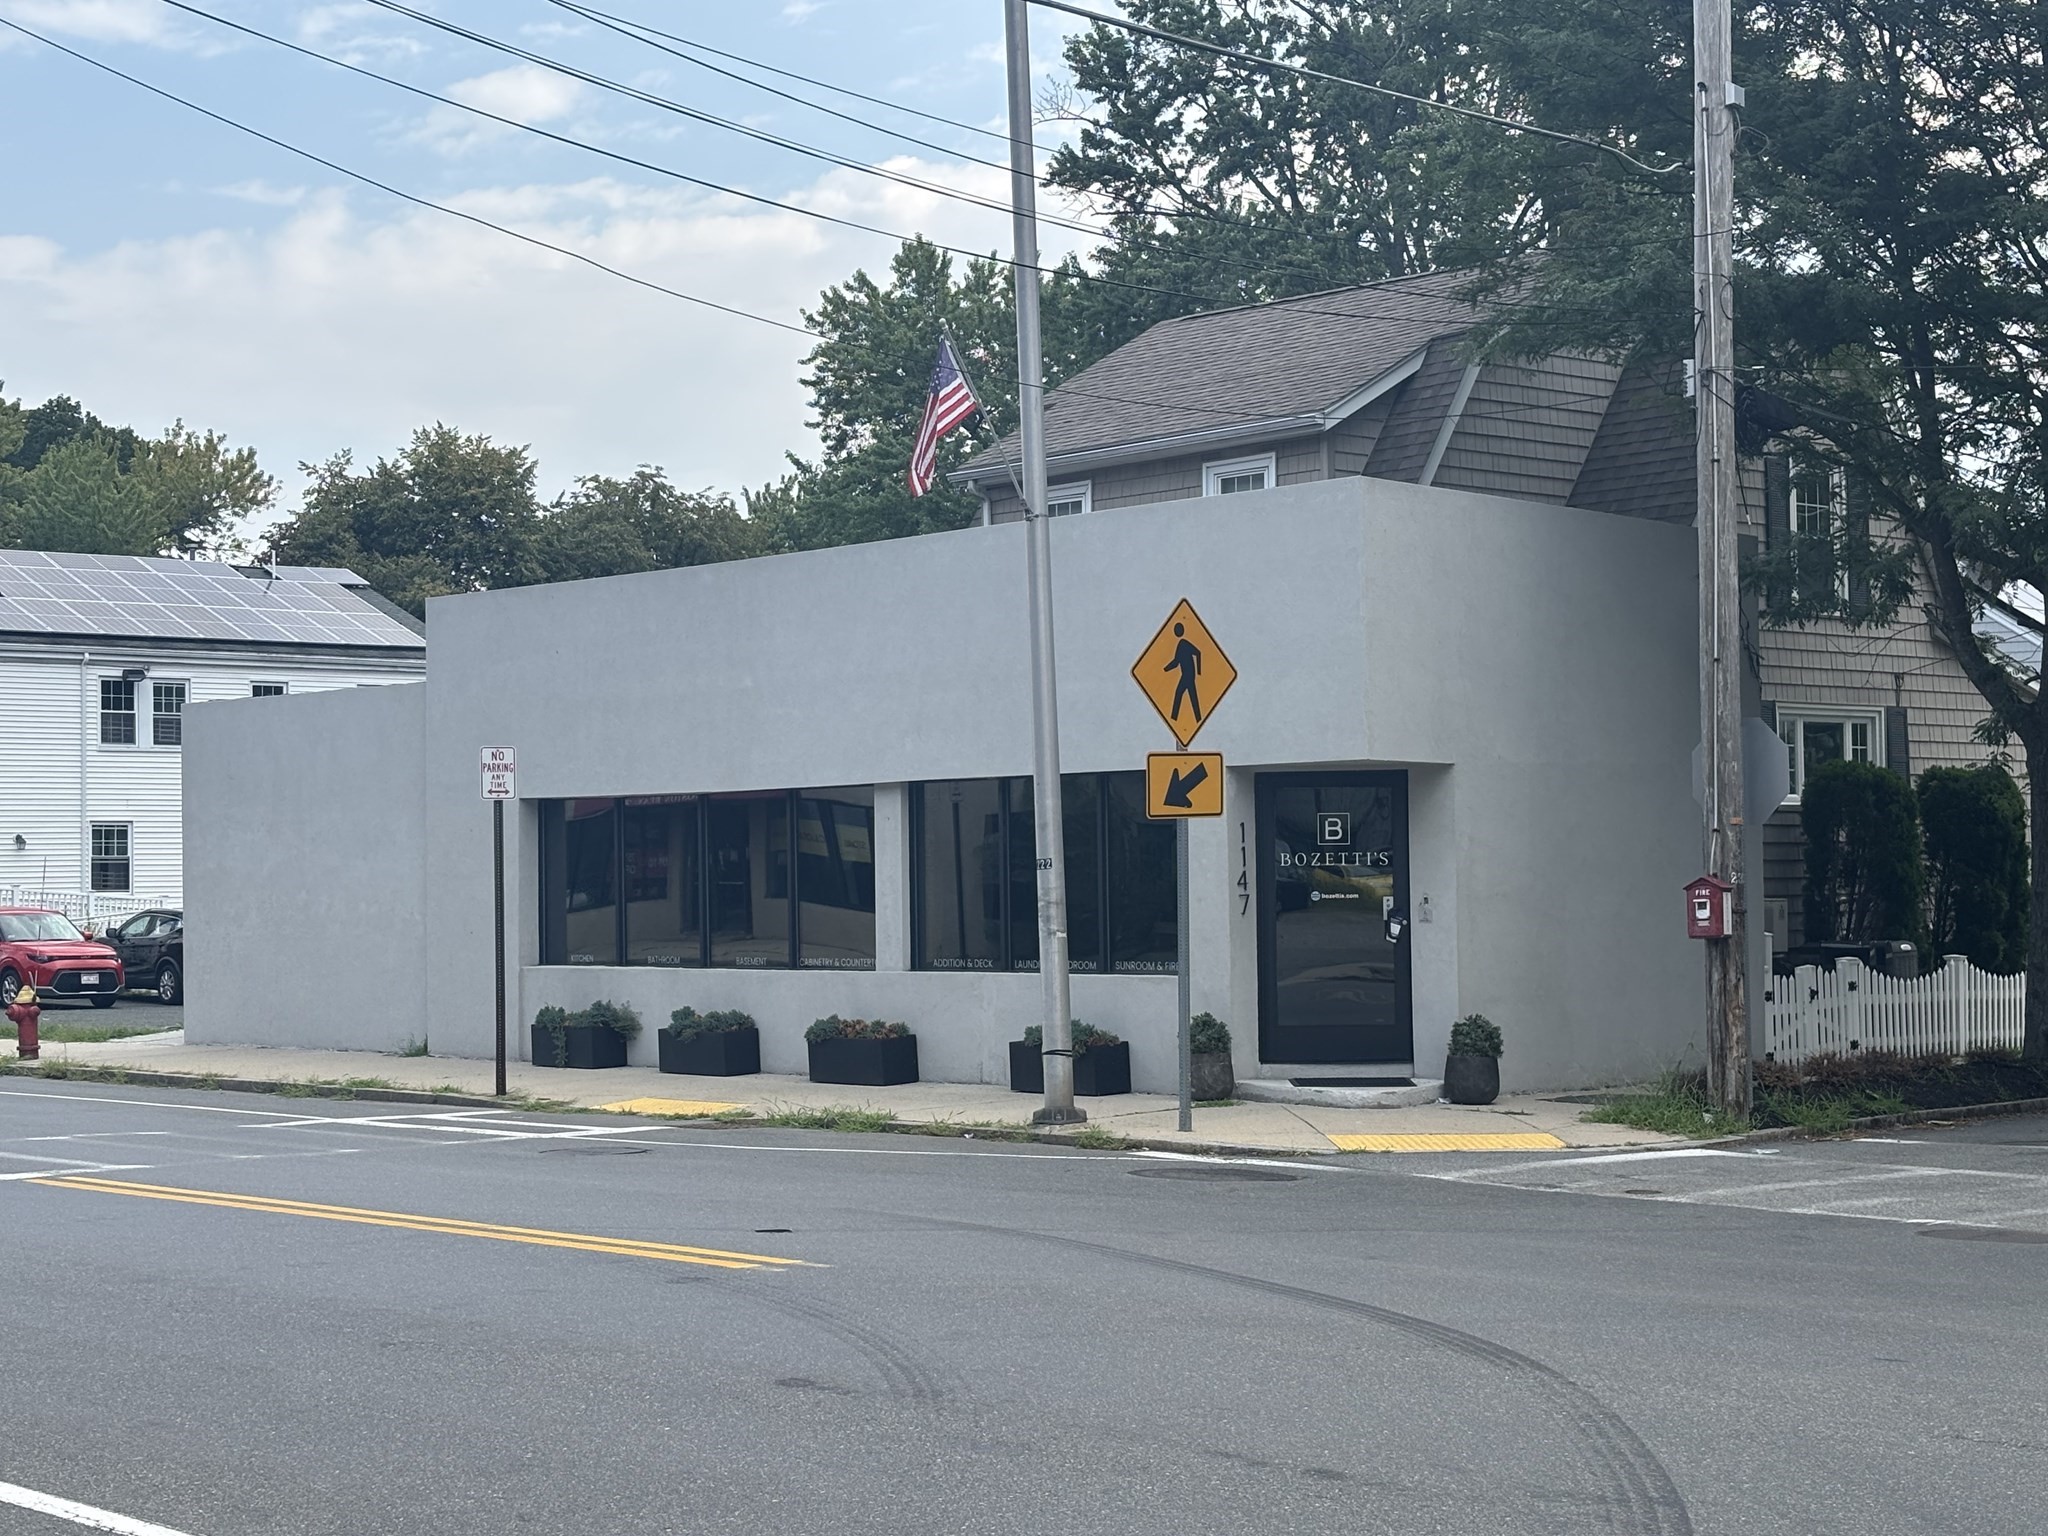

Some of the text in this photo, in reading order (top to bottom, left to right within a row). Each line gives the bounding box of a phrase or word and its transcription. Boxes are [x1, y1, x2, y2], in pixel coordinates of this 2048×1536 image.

[491, 751, 505, 761] NO
[482, 763, 514, 773] PARKING
[1324, 817, 1343, 841] B
[1279, 851, 1389, 867] BOZETTI'S
[1695, 888, 1711, 896] FIRE
[570, 954, 594, 963] KITCHEN
[647, 955, 681, 964] BATHROOM
[735, 957, 768, 966] BASEMENT
[799, 957, 877, 968] CABINETRY & COUNTERT
[933, 958, 994, 968] ADDITION & DECK
[1014, 959, 1040, 969] LAUND
[1115, 960, 1155, 970] SUNROOM
[1156, 961, 1163, 970] &
